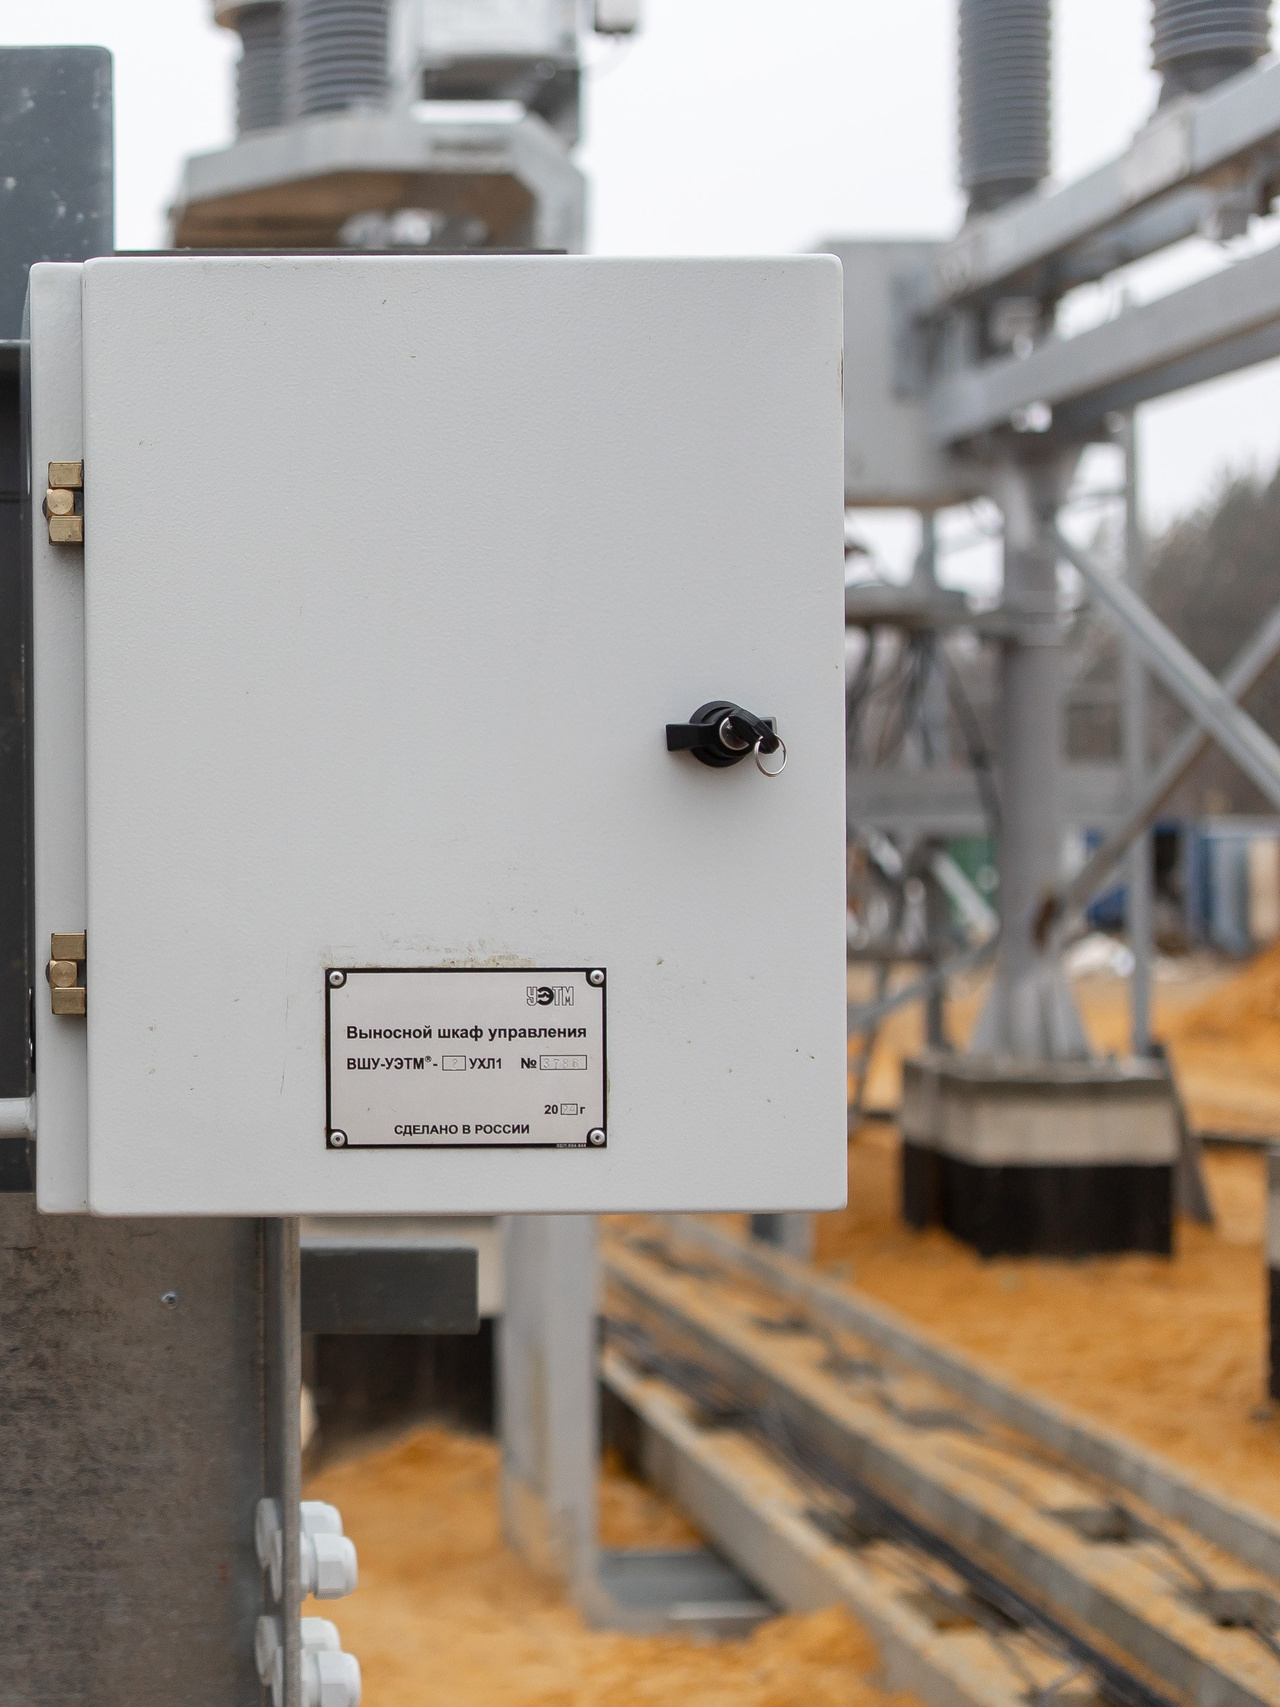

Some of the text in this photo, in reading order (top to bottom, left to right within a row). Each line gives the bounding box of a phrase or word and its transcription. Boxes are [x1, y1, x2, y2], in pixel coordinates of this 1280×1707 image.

[526, 986, 574, 1006] УЭТМ
[346, 1025, 587, 1042] Выносной шкаф управления
[469, 1058, 502, 1070] УХЛ1
[521, 1057, 537, 1069] №
[394, 1124, 530, 1136] СДЕЛАНО В РОССИИ
